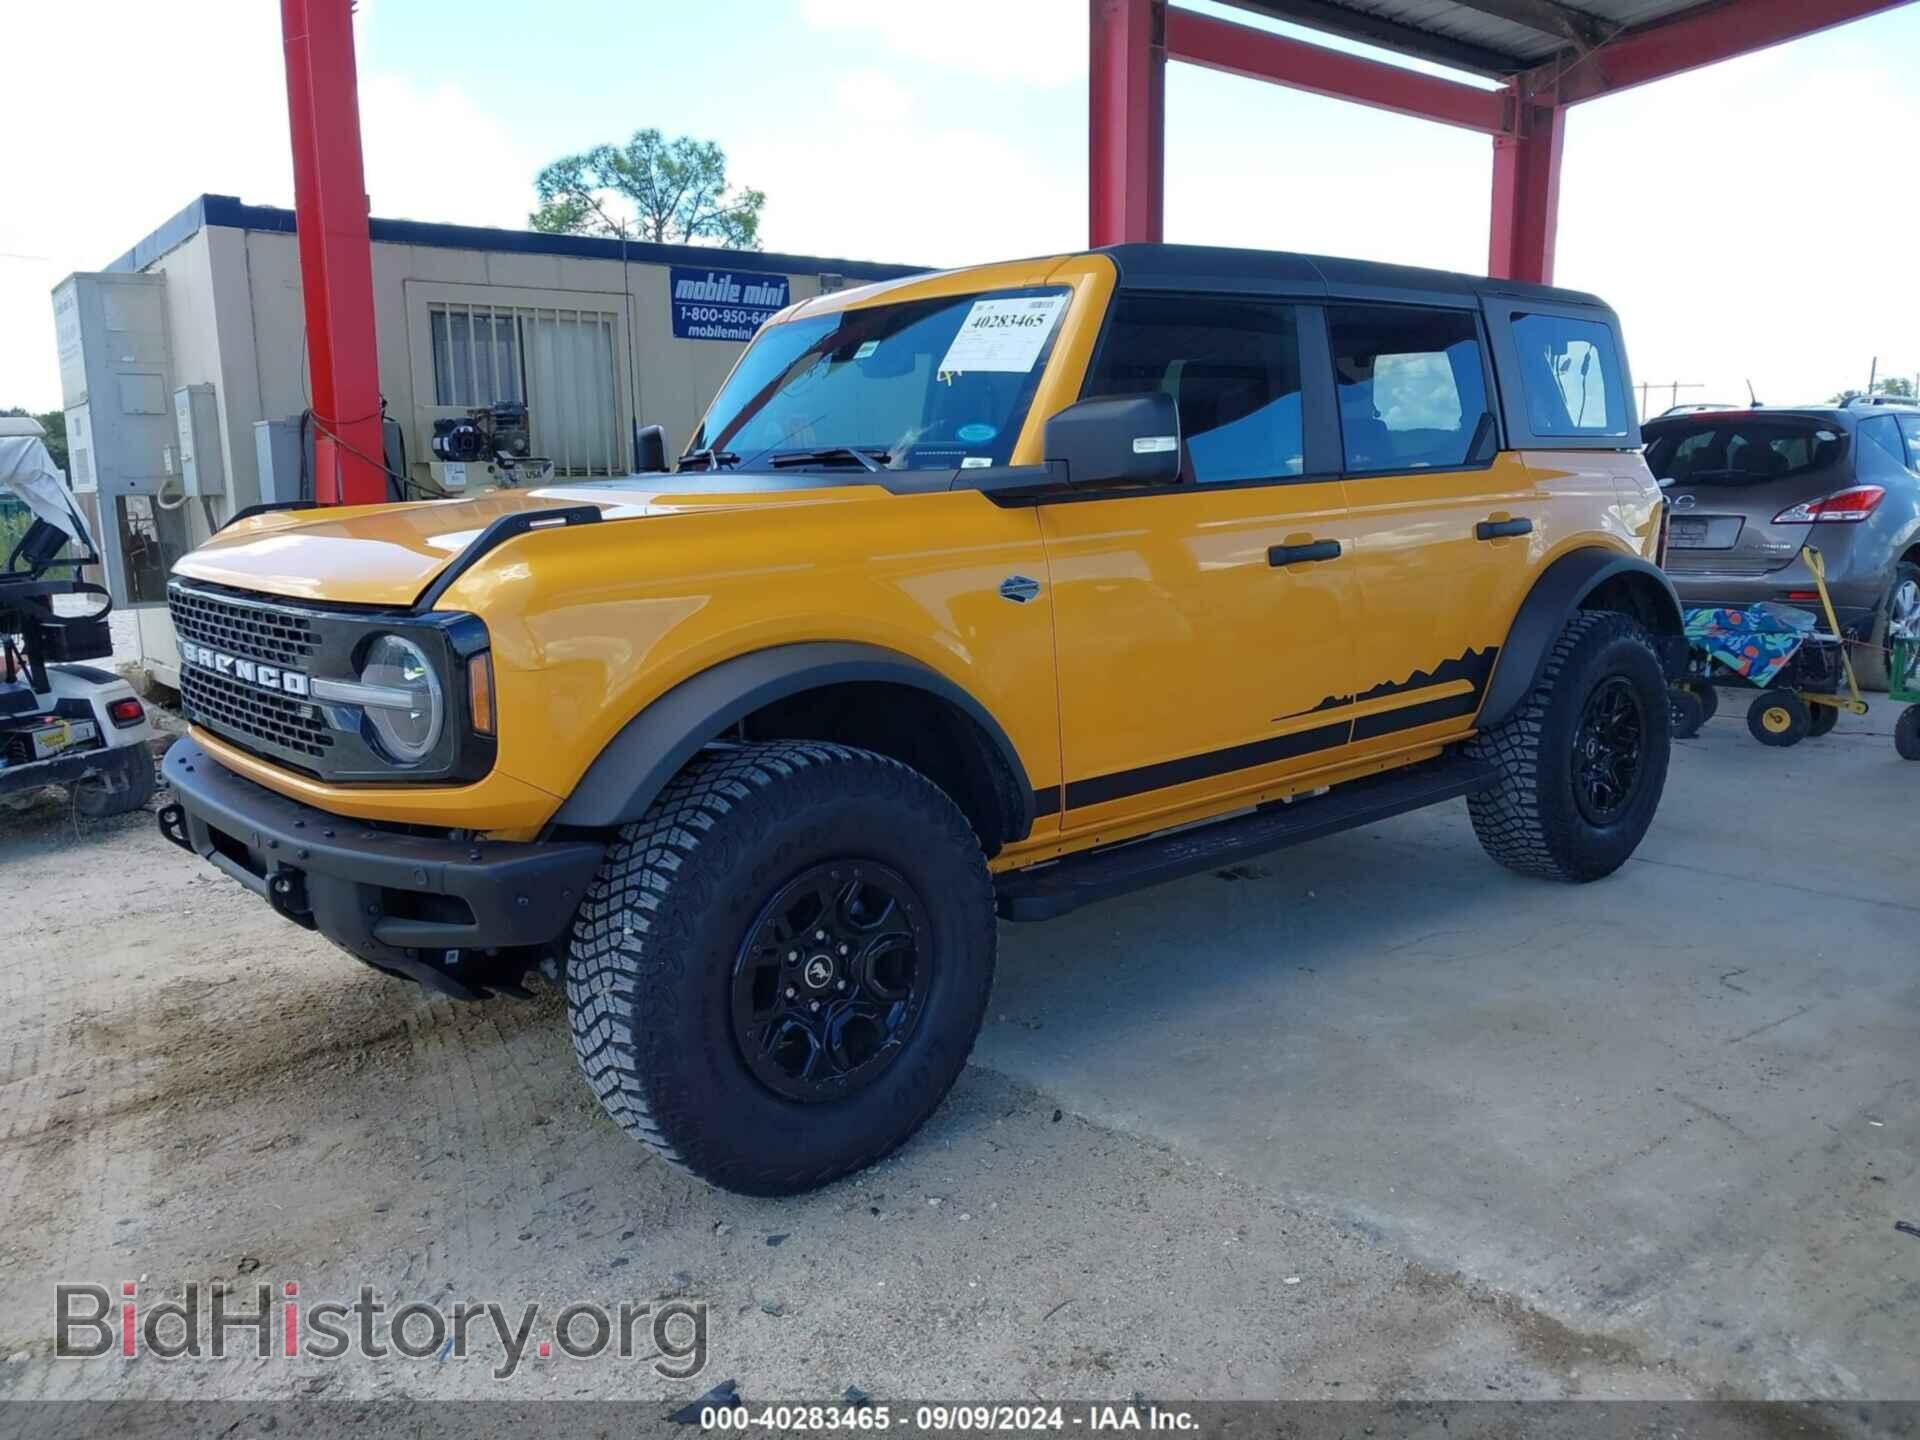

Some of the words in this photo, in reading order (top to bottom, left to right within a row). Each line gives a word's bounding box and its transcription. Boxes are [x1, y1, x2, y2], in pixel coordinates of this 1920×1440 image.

[675, 272, 741, 303] mobile
[744, 281, 786, 306] mini
[681, 305, 774, 325] 1-800-950-64
[972, 313, 1046, 329] 40283465
[182, 641, 309, 696] BRONCO
